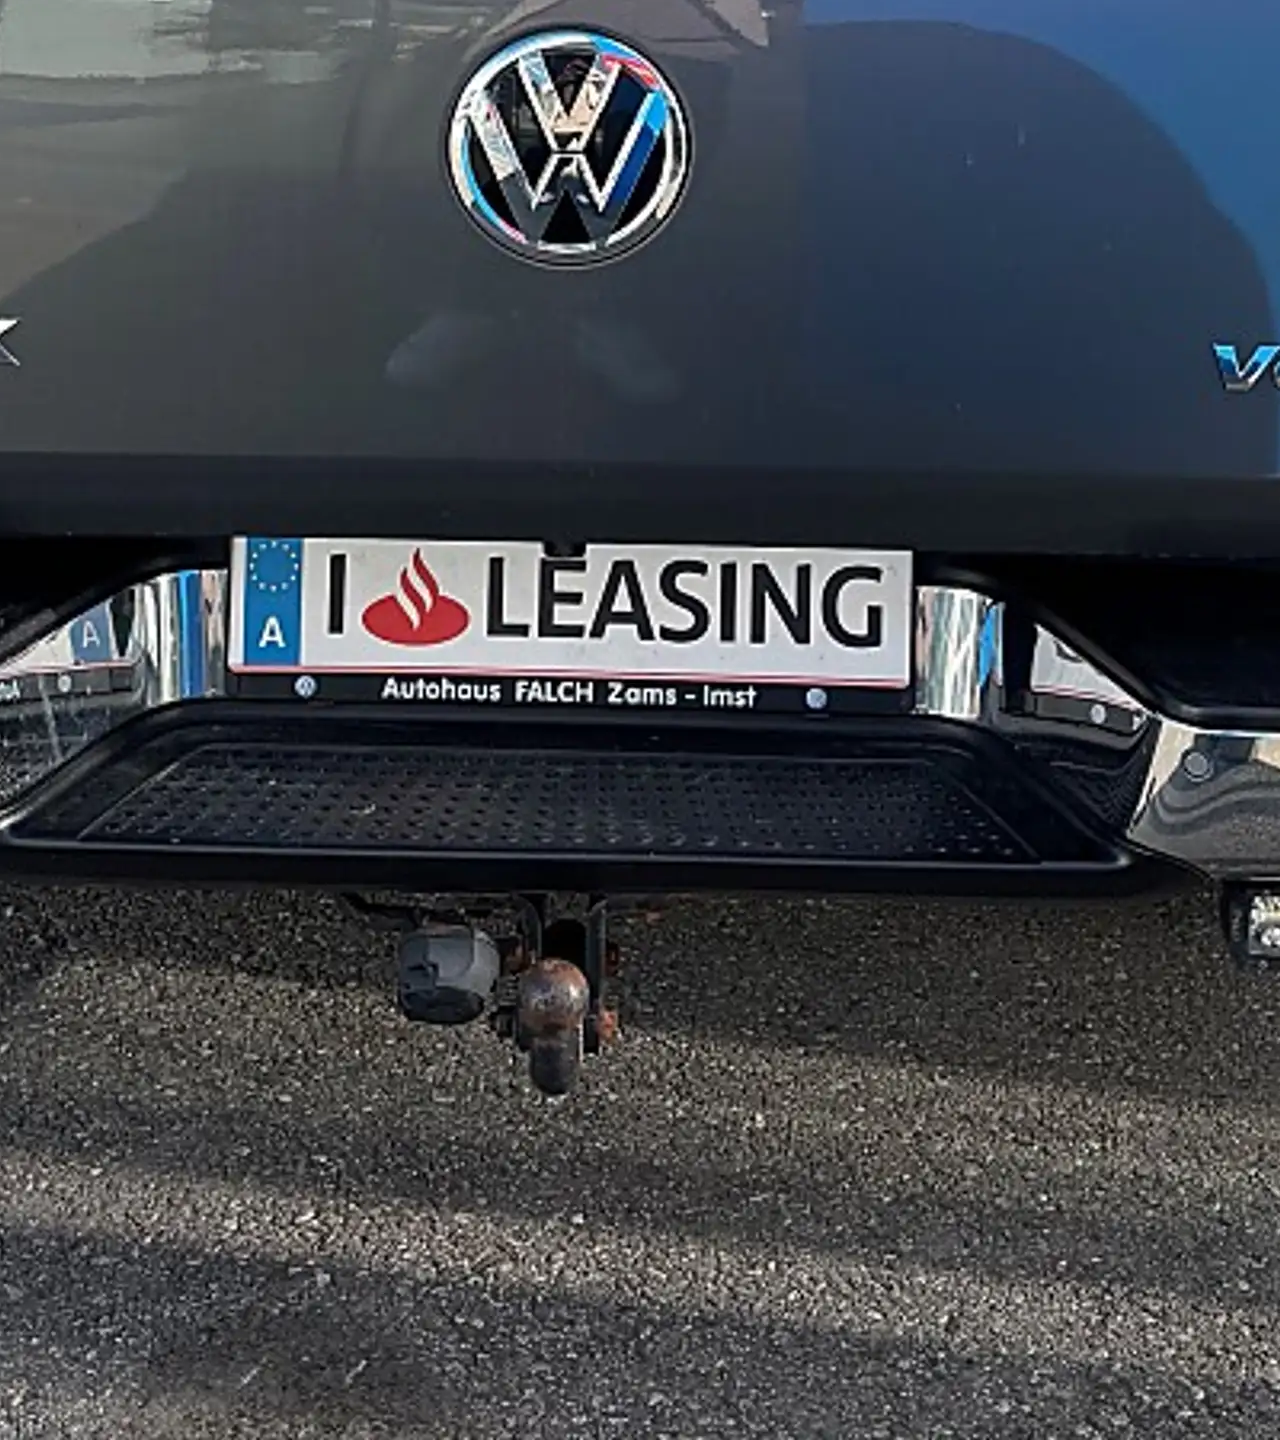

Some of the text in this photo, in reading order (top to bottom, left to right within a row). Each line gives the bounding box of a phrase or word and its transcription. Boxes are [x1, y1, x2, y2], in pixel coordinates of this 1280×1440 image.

[328, 554, 882, 647] I LEASING
[258, 618, 286, 648] A
[381, 676, 501, 702] Autohaus
[515, 681, 594, 703] FALCH
[607, 681, 677, 706] Zams
[703, 684, 757, 708] Imst
